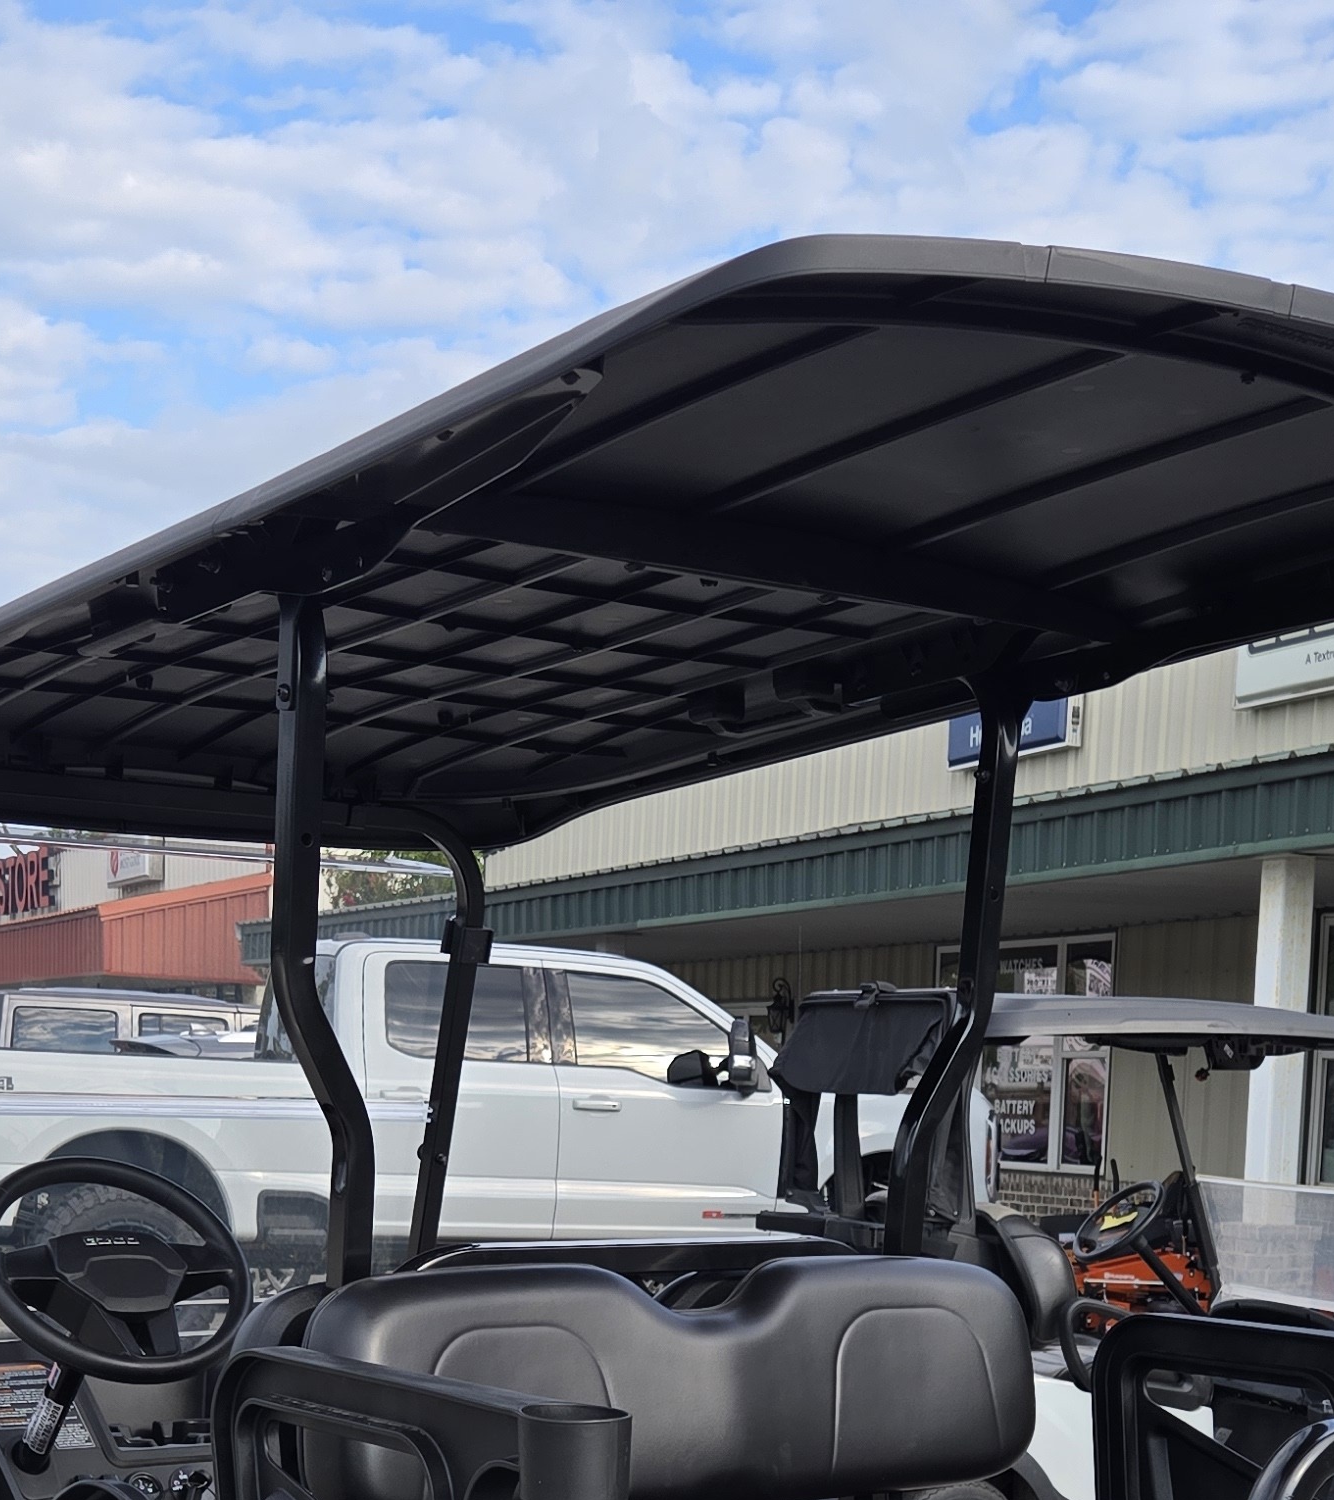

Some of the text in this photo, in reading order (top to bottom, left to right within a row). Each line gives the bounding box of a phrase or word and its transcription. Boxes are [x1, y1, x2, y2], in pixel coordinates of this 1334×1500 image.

[1305, 653, 1312, 665] A
[999, 957, 1044, 976] WATCHES
[994, 1099, 1036, 1116] BATTERY
[1000, 1118, 1036, 1136] ACKUPS
